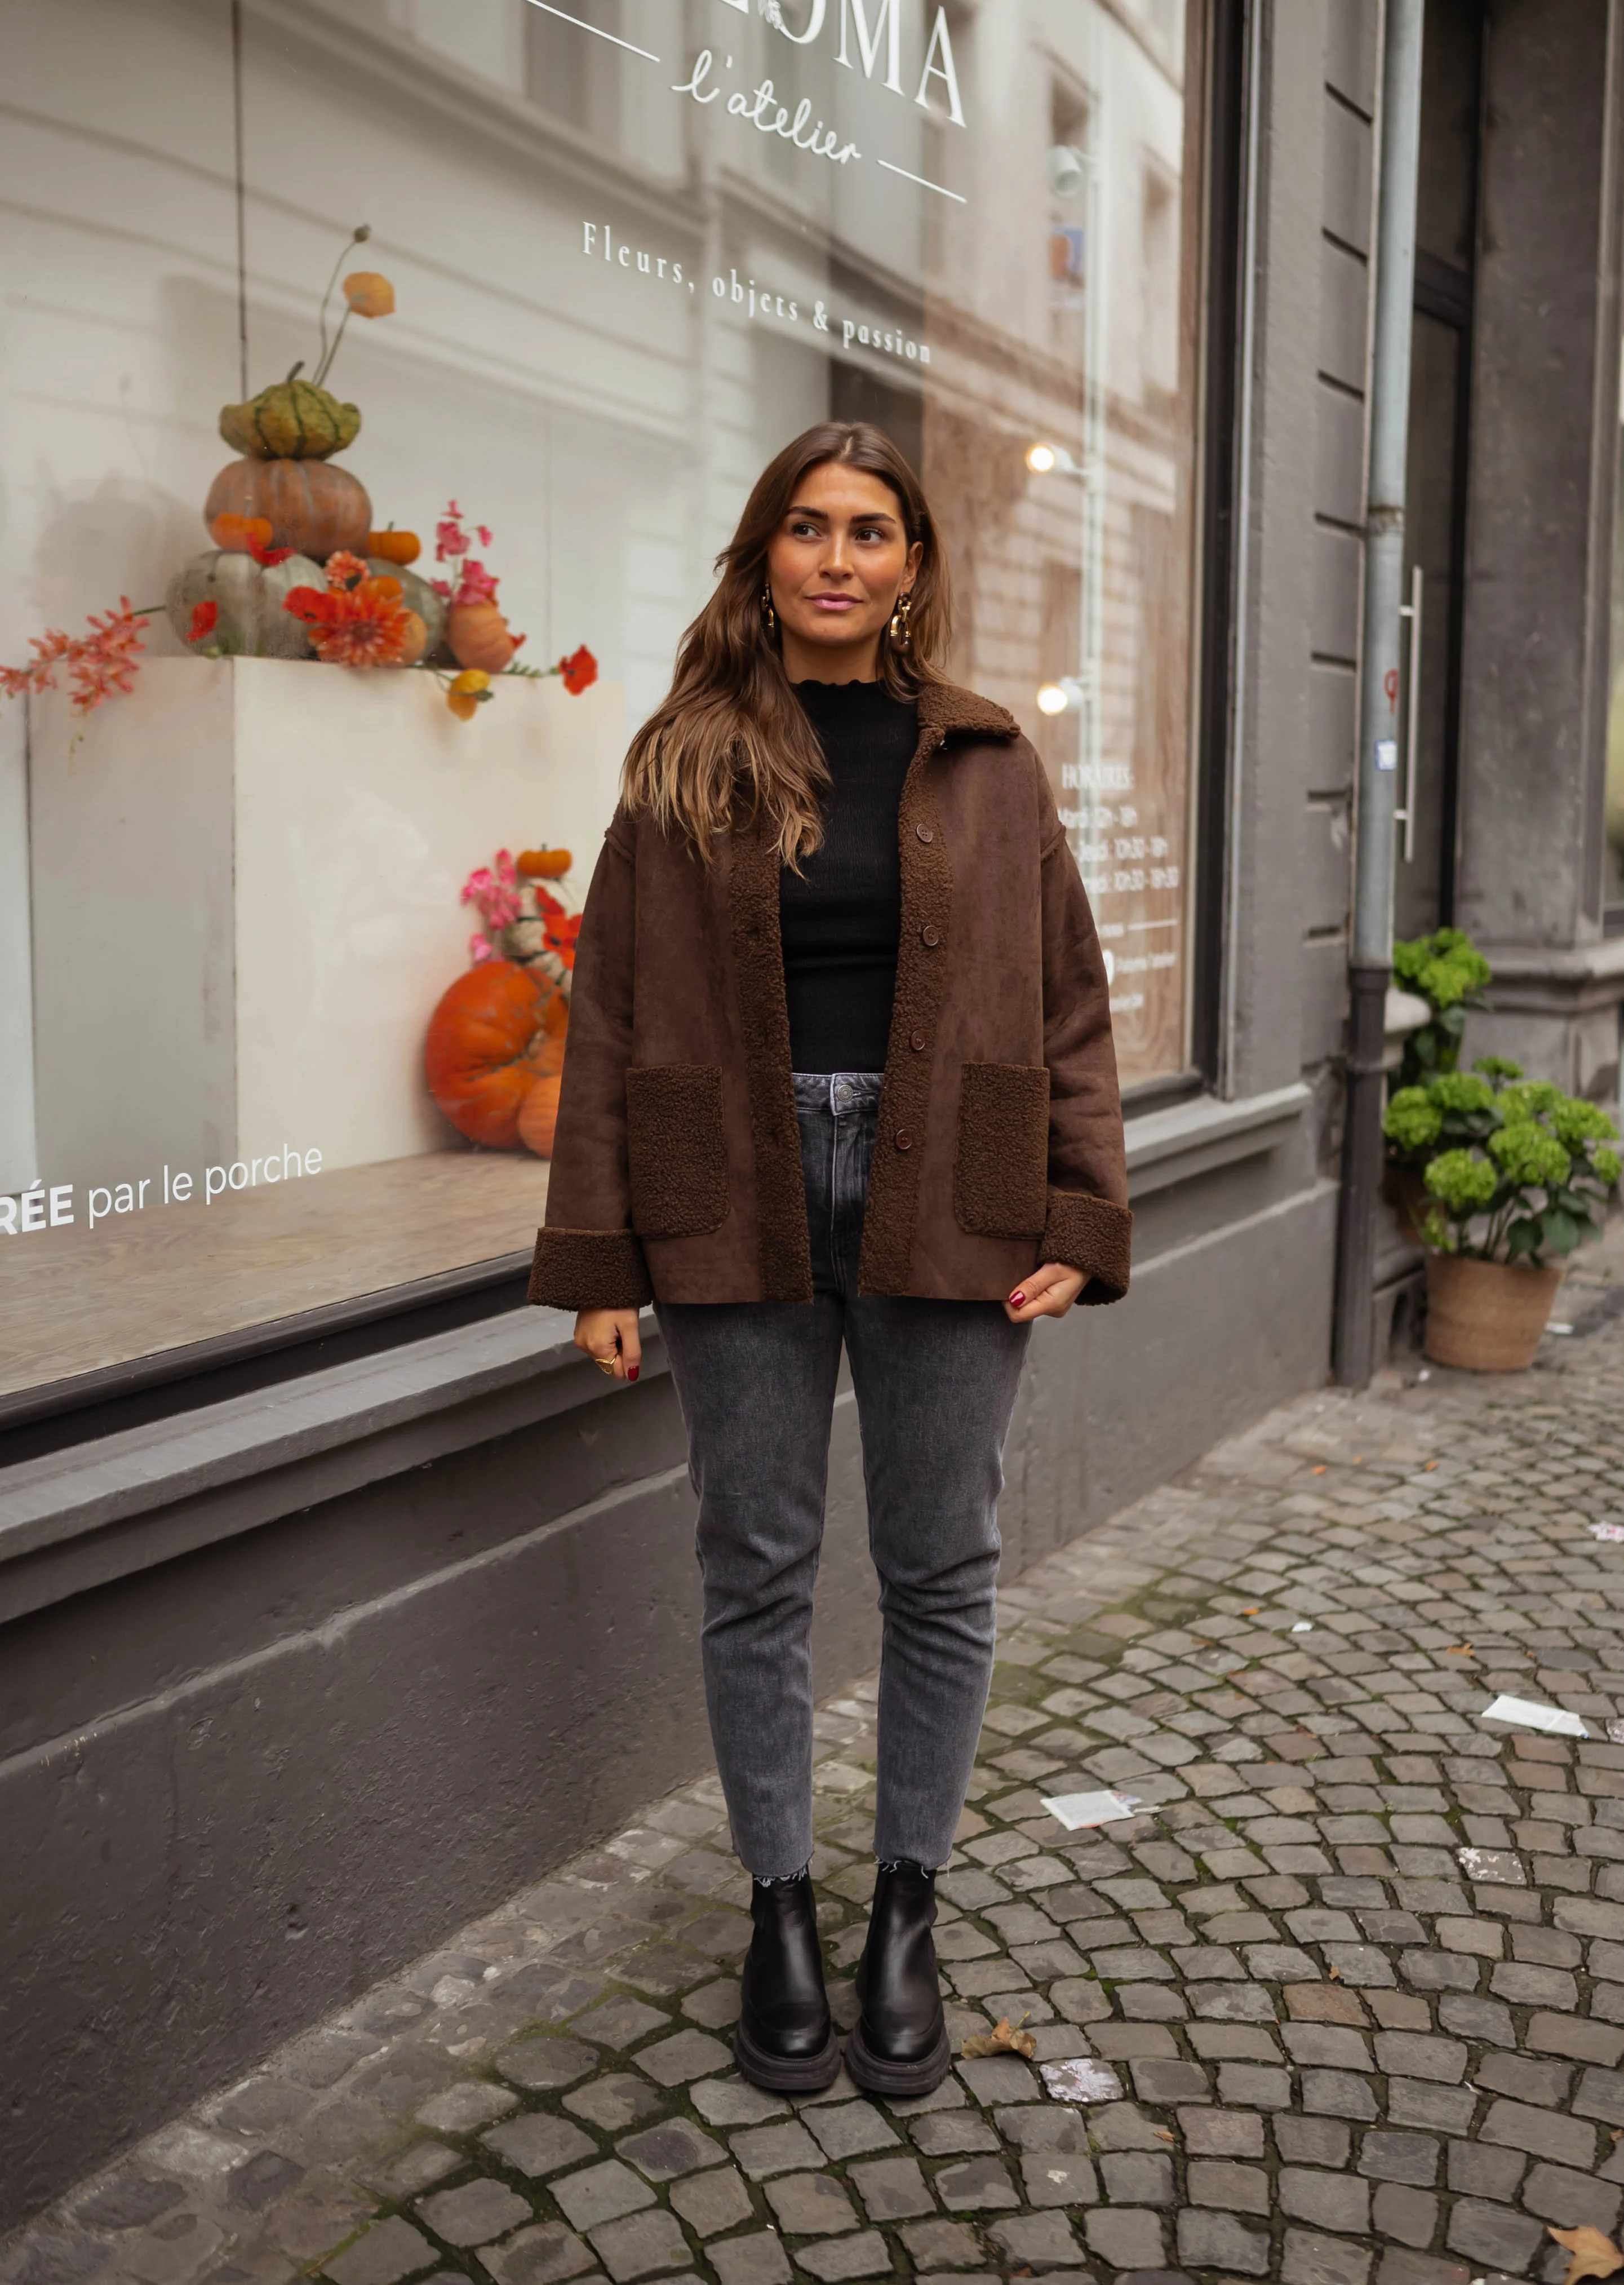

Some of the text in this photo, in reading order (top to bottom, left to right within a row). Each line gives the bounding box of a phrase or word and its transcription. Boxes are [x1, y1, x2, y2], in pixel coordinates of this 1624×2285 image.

[671, 50, 862, 164] l'atelier
[582, 221, 932, 365] Fleurs, objets & passion
[88, 1179, 151, 1229] par
[163, 1164, 193, 1205] le
[206, 1143, 323, 1206] porche
